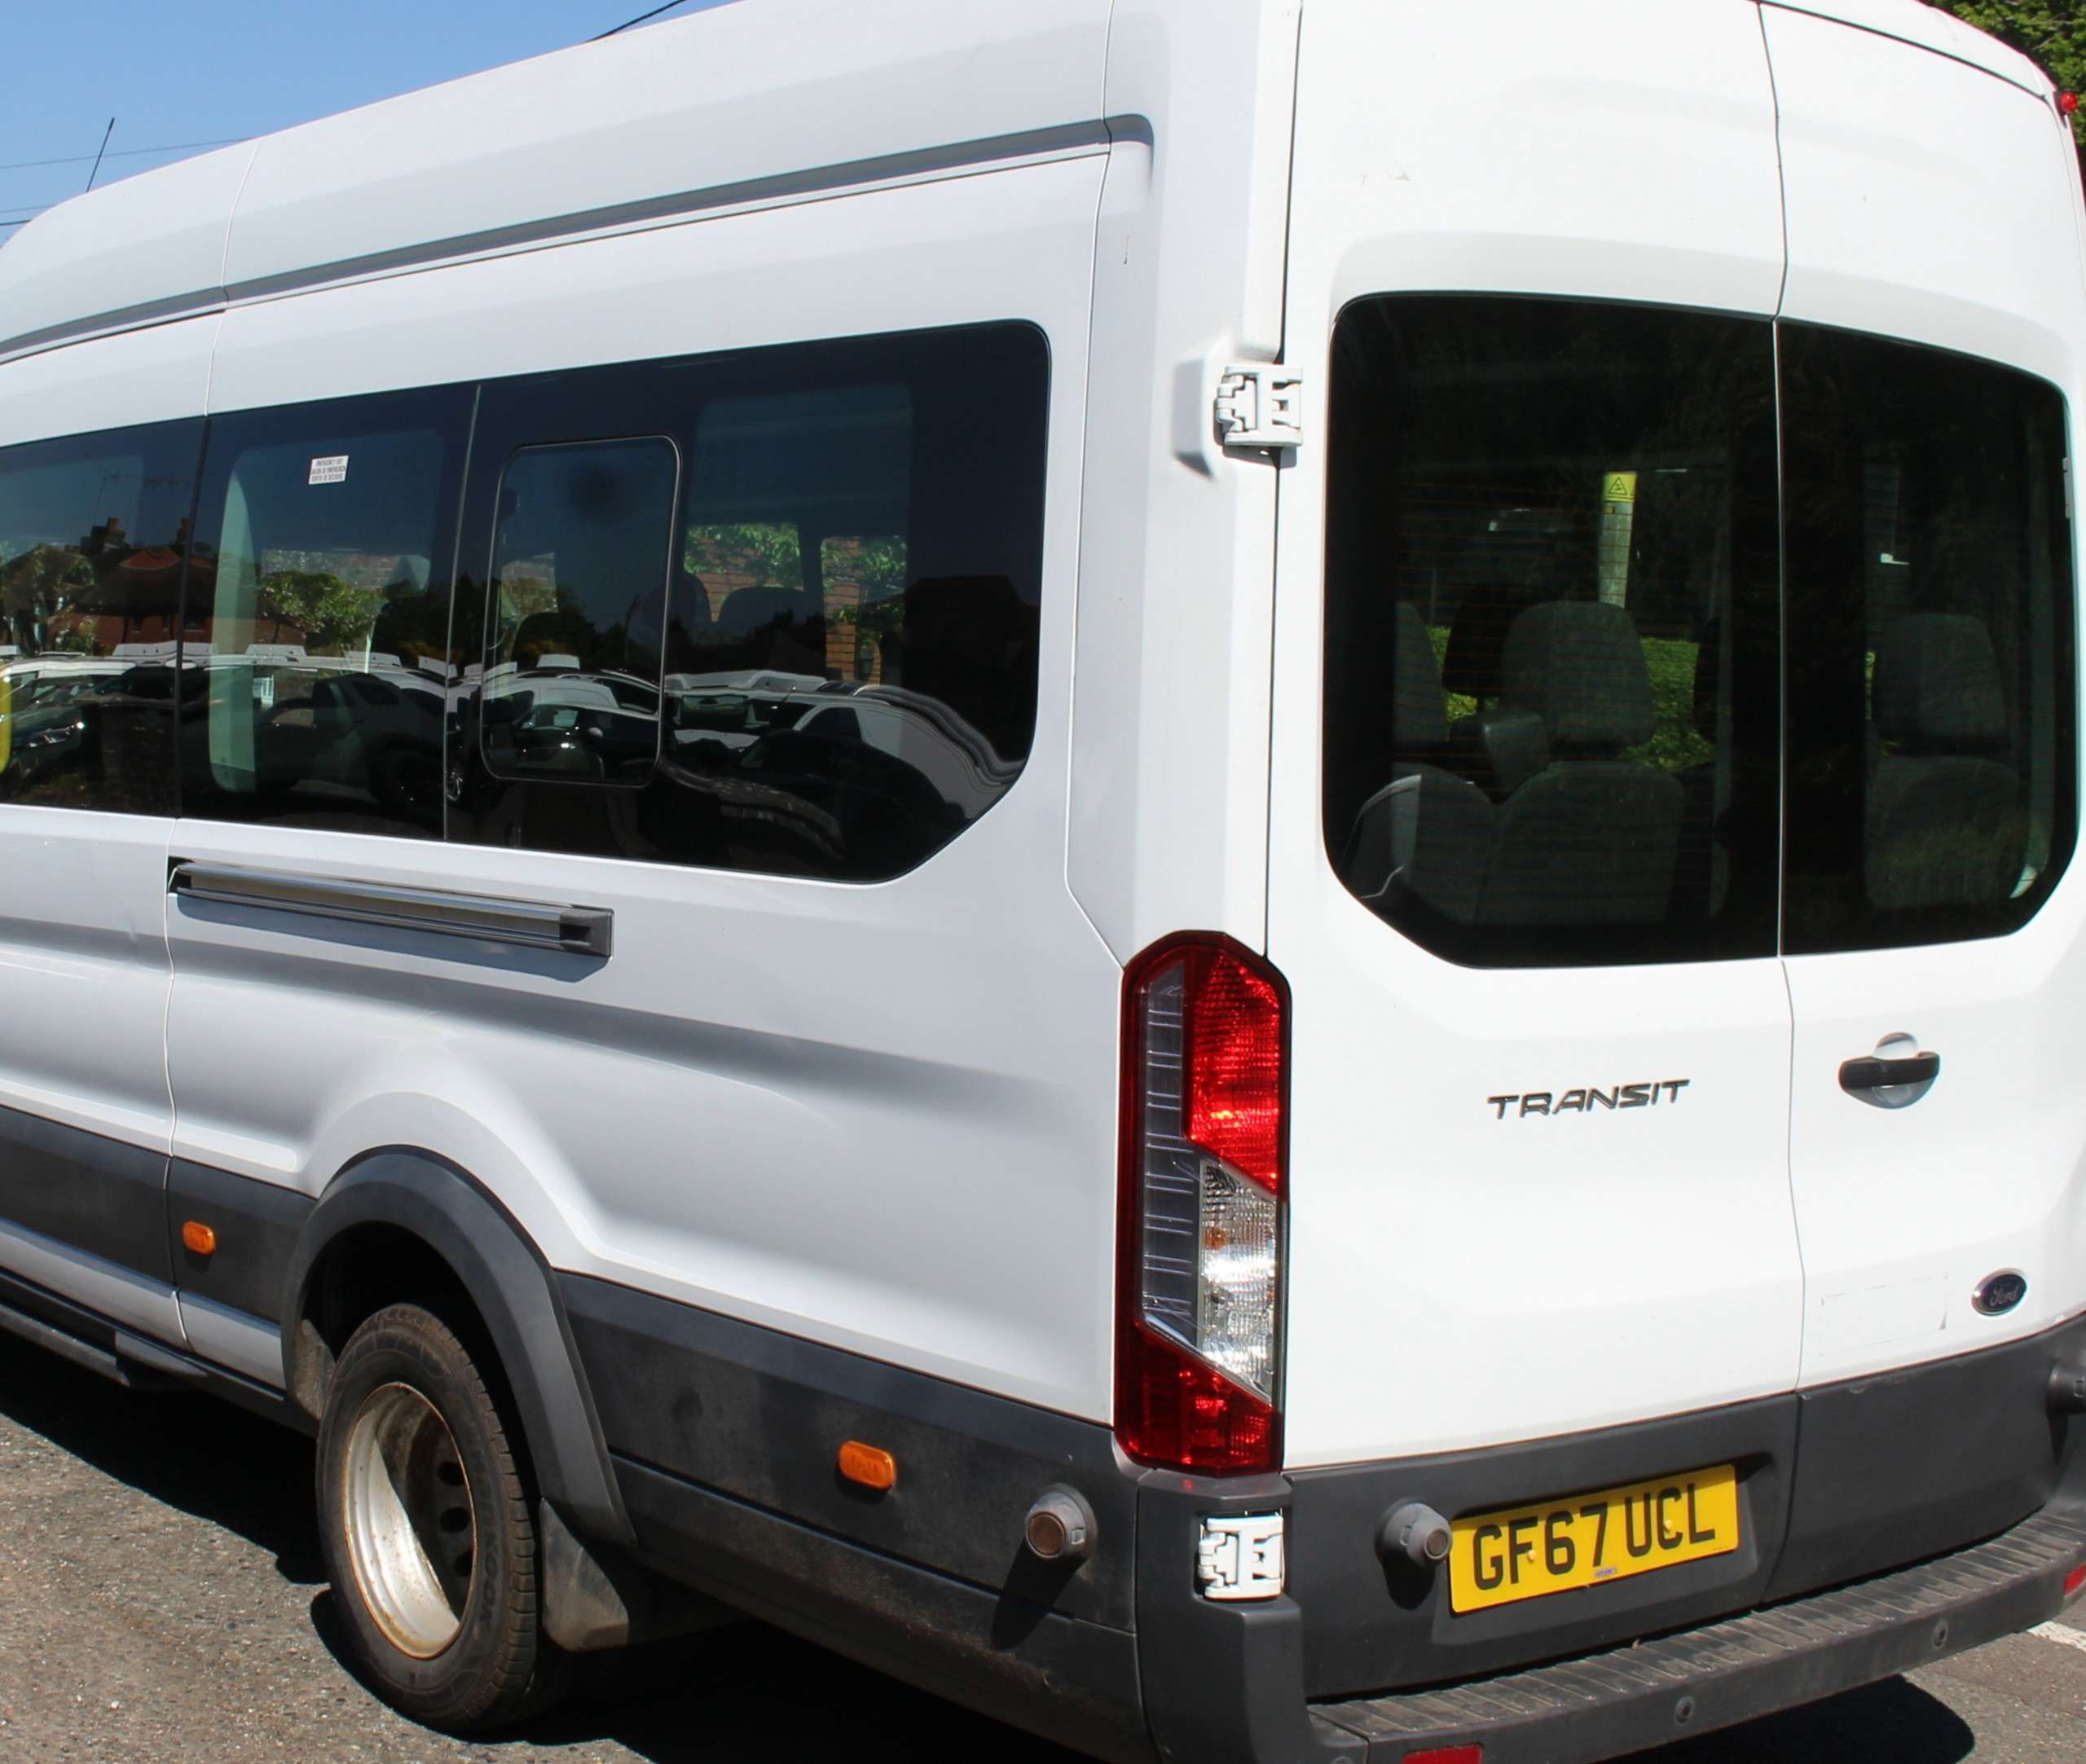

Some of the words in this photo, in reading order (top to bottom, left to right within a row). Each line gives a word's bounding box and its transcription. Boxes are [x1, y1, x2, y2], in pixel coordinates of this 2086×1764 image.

[1488, 1080, 1690, 1120] TRANSIT
[1989, 1284, 2019, 1307] Ford
[1473, 1502, 1609, 1590] GF67
[1626, 1483, 1716, 1557] UCL
